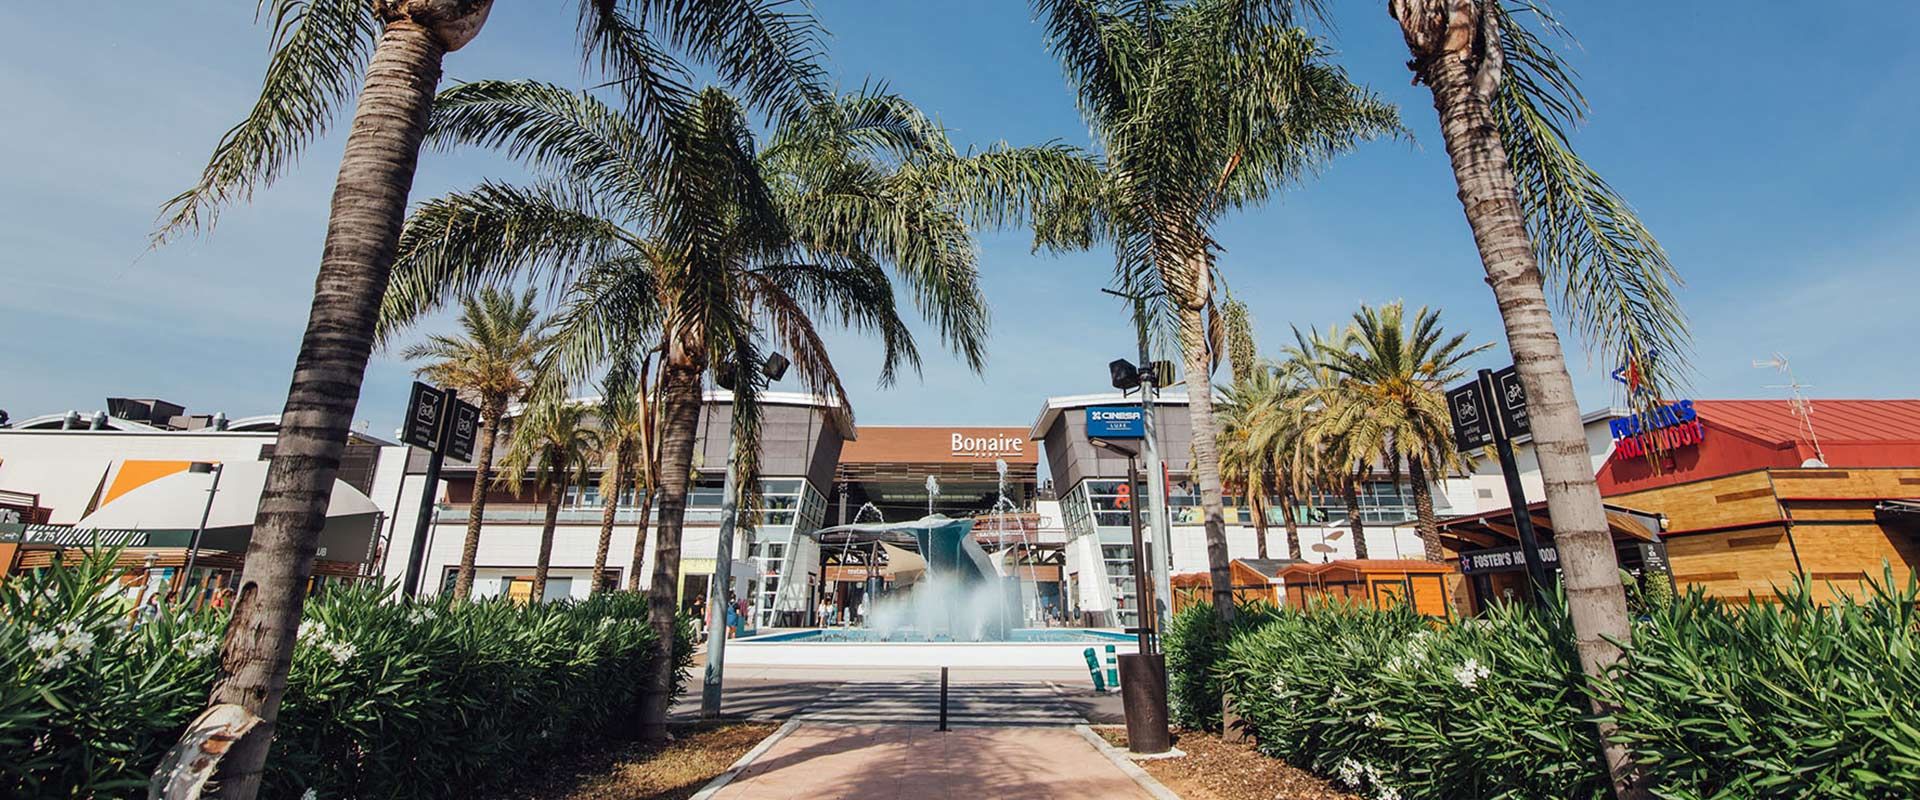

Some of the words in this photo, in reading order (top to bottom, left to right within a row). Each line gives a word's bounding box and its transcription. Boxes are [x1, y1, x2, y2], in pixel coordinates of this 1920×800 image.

[1101, 411, 1141, 420] CINESA
[951, 432, 1023, 452] Bonaire
[35, 530, 56, 541] 2.75
[1472, 551, 1513, 569] FOSTER'S
